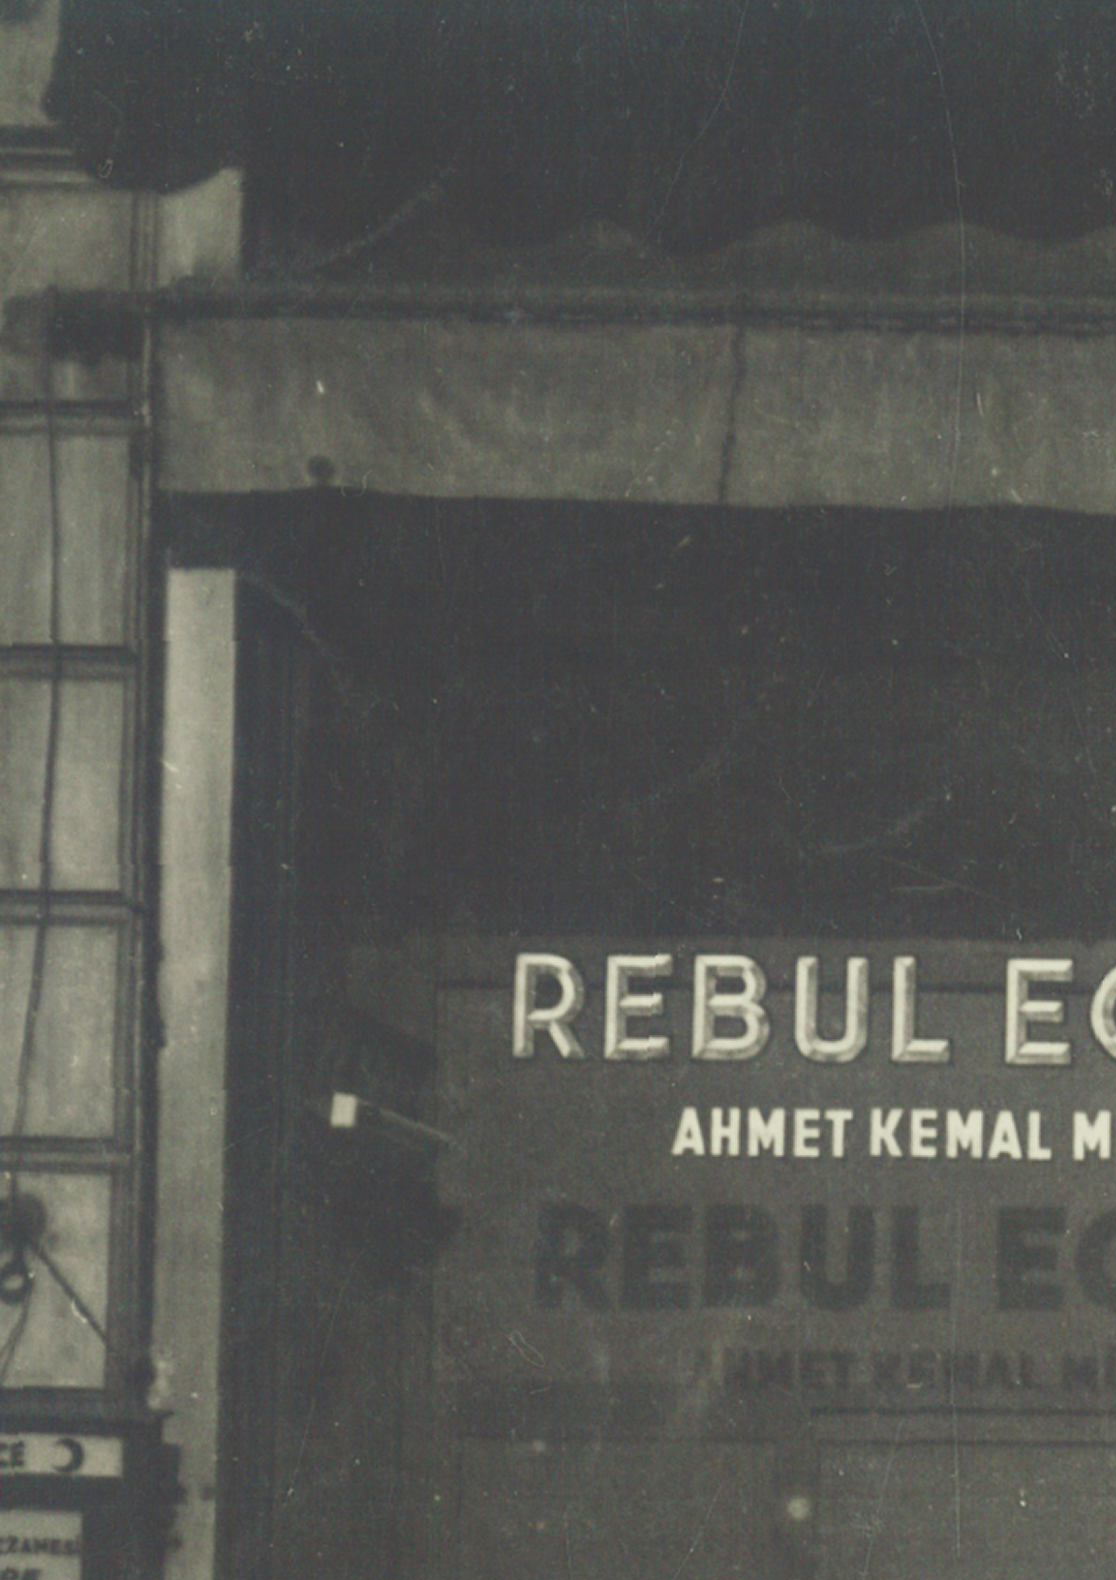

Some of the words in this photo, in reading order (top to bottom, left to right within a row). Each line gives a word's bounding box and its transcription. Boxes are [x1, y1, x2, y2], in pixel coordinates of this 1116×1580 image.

[512, 951, 951, 1063] REBUL
[670, 1106, 855, 1158] AHMET
[868, 1107, 1053, 1161] KEMAL
[535, 1201, 951, 1311] REBUL
